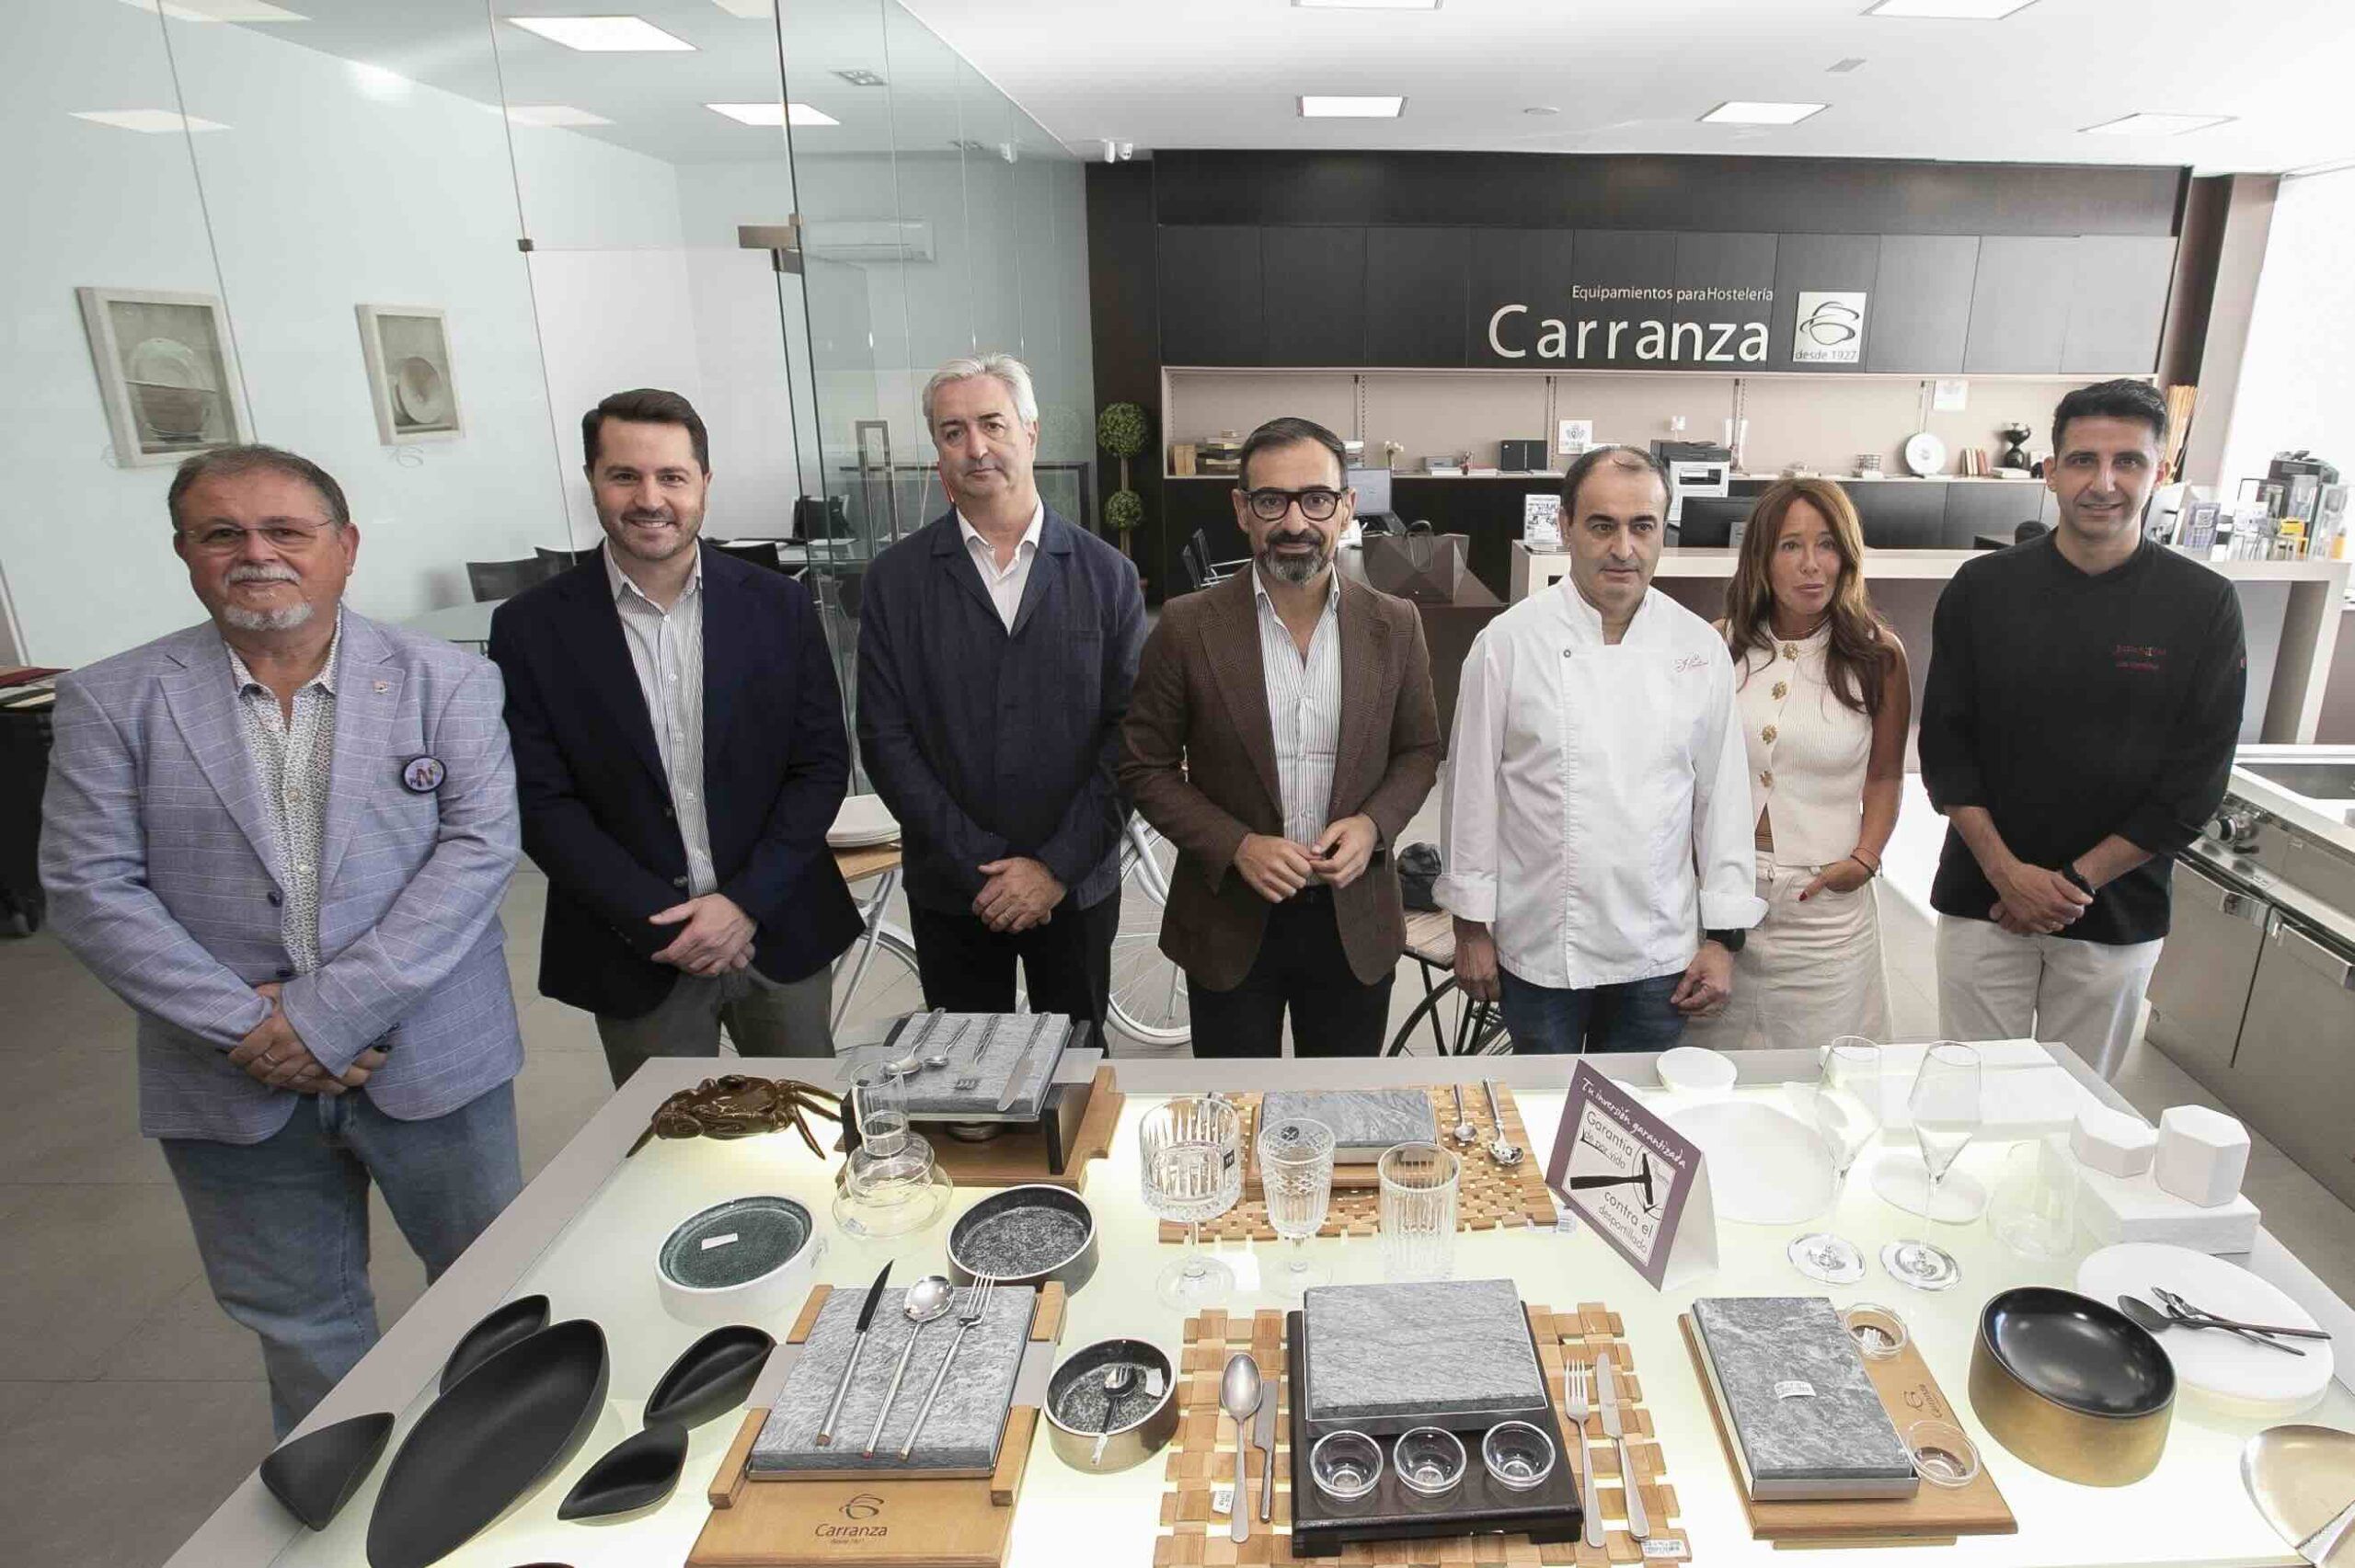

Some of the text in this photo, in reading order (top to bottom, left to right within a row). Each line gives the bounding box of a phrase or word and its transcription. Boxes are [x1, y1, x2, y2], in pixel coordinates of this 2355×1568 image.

[1572, 284, 1672, 302] Equipamientos
[1488, 303, 1769, 362] Carranza
[1795, 349, 1856, 361] desde 1927
[1581, 1077, 1686, 1170] Tu inversión garantizada
[1604, 1191, 1654, 1238] contra el
[814, 1523, 889, 1537] Carranza
